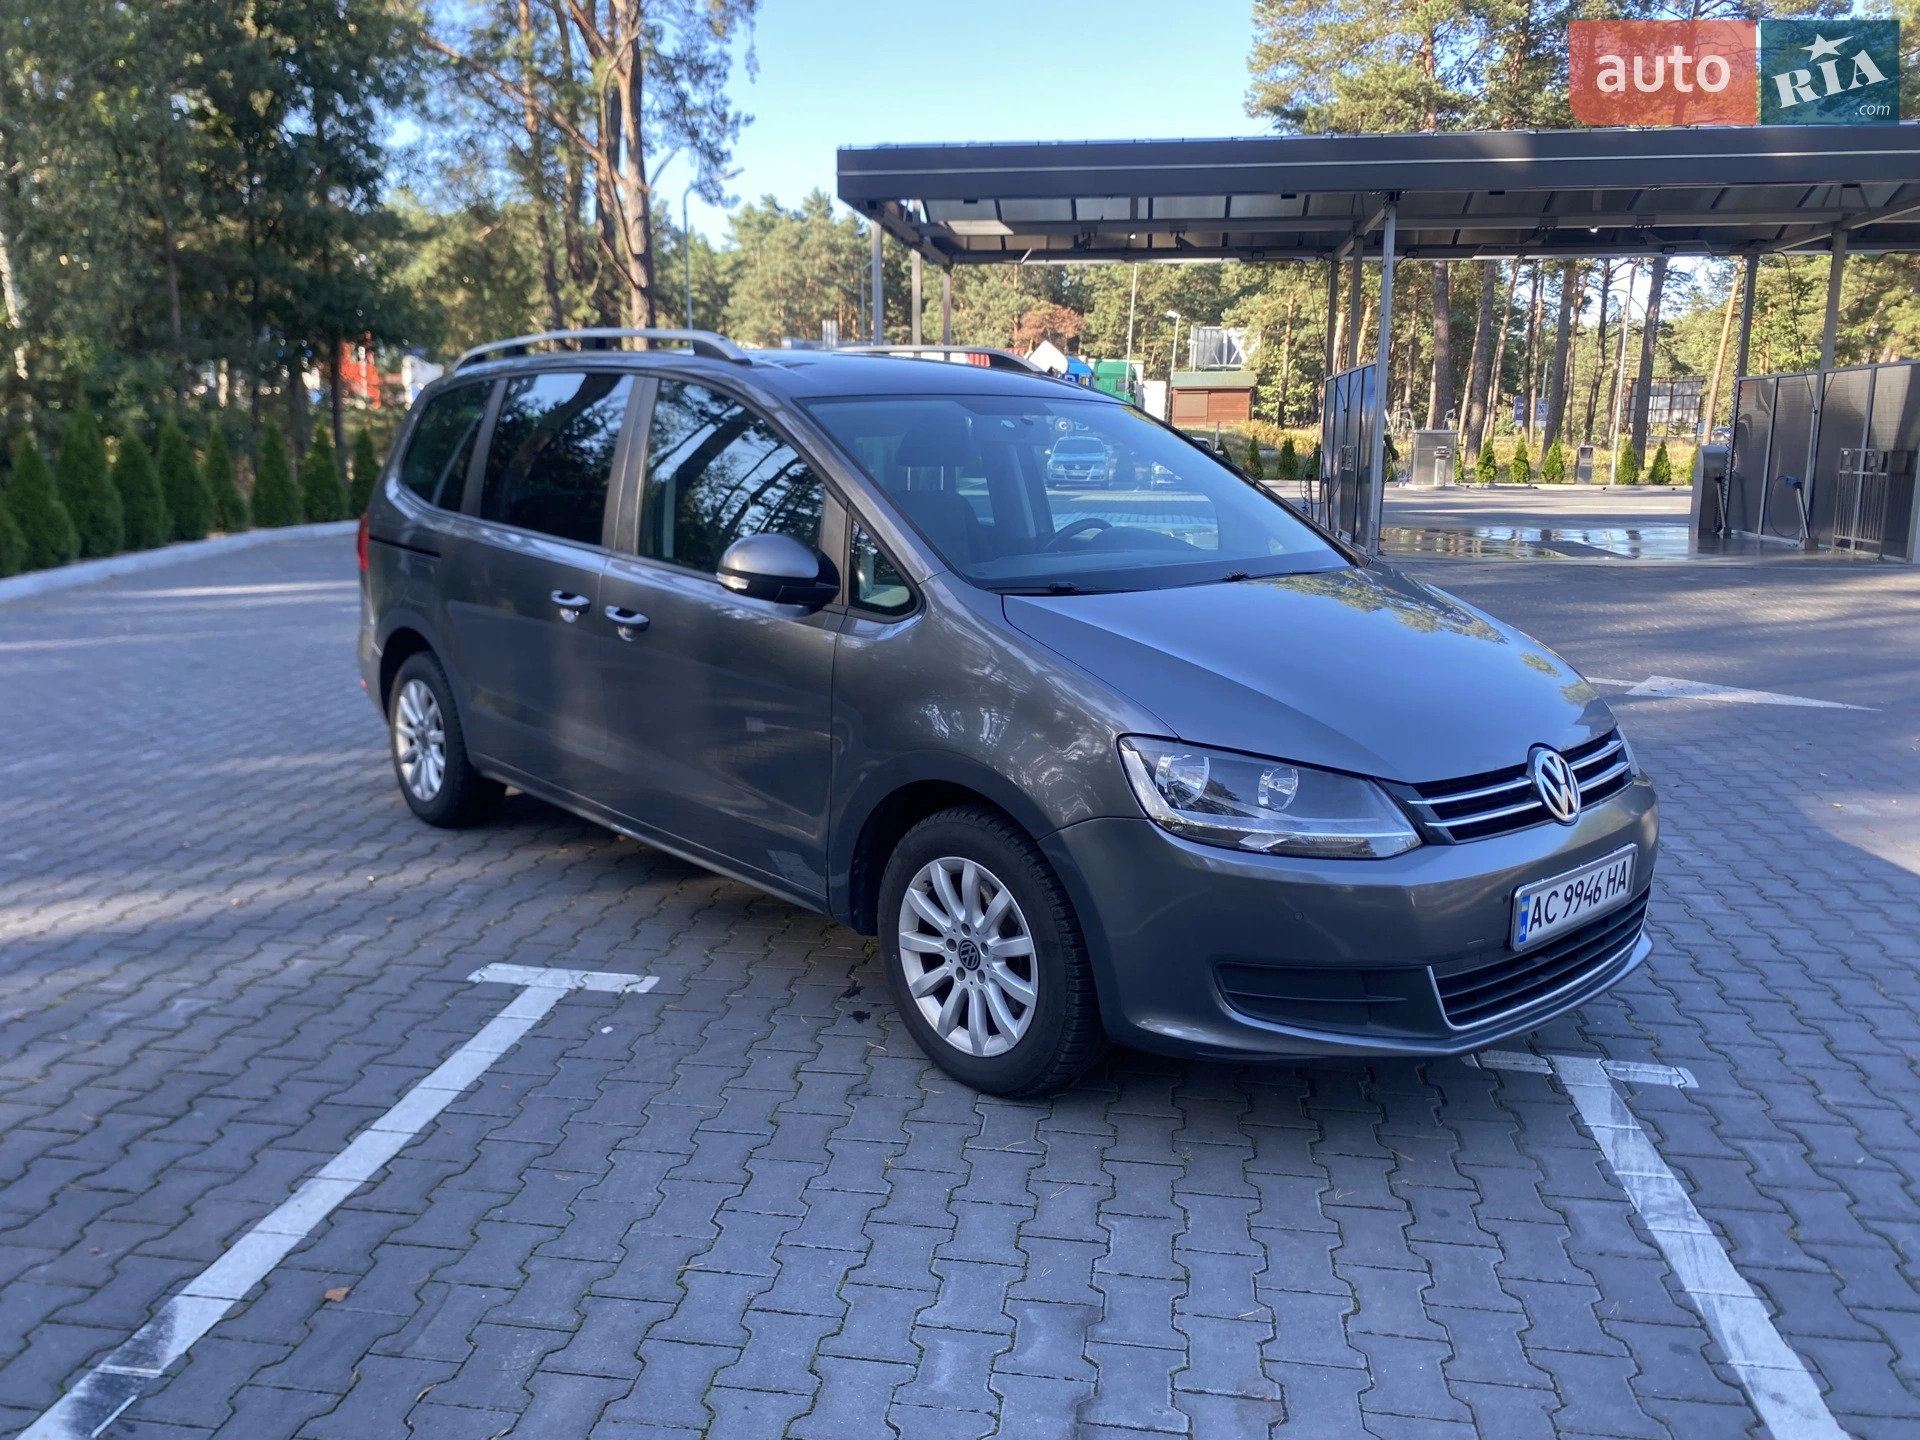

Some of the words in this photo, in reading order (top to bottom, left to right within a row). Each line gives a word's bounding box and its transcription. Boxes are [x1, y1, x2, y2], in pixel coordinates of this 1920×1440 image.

[1528, 890, 1559, 933] AC
[1562, 870, 1604, 919] 9946
[1605, 860, 1627, 900] HA
